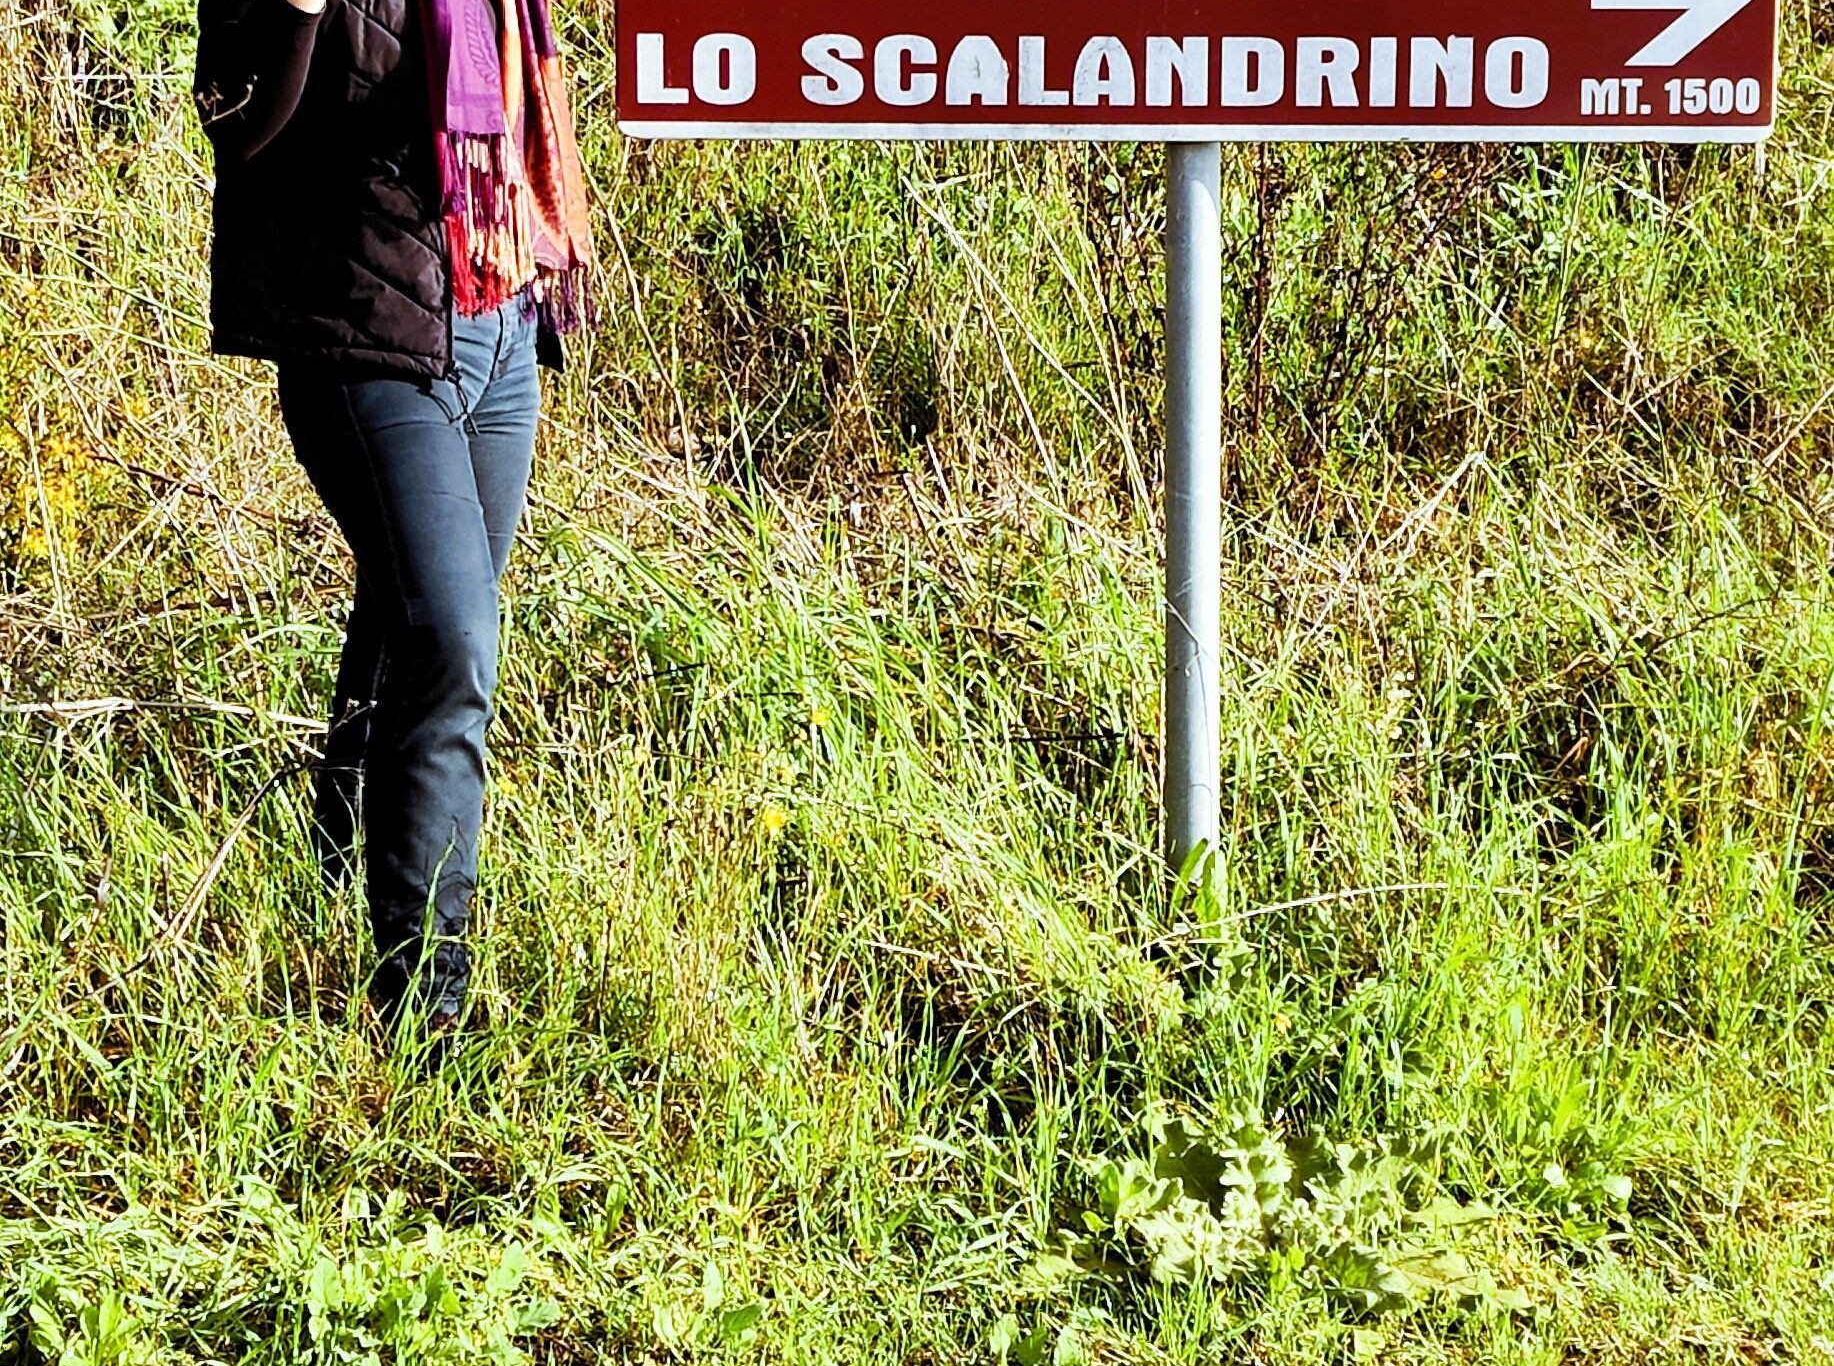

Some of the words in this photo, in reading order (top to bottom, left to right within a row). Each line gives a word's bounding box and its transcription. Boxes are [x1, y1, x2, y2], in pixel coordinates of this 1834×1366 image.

[636, 32, 757, 106] LO
[800, 33, 1550, 109] SCALANDRINO
[1581, 77, 1652, 116] MT.
[1664, 77, 1761, 116] 1500
